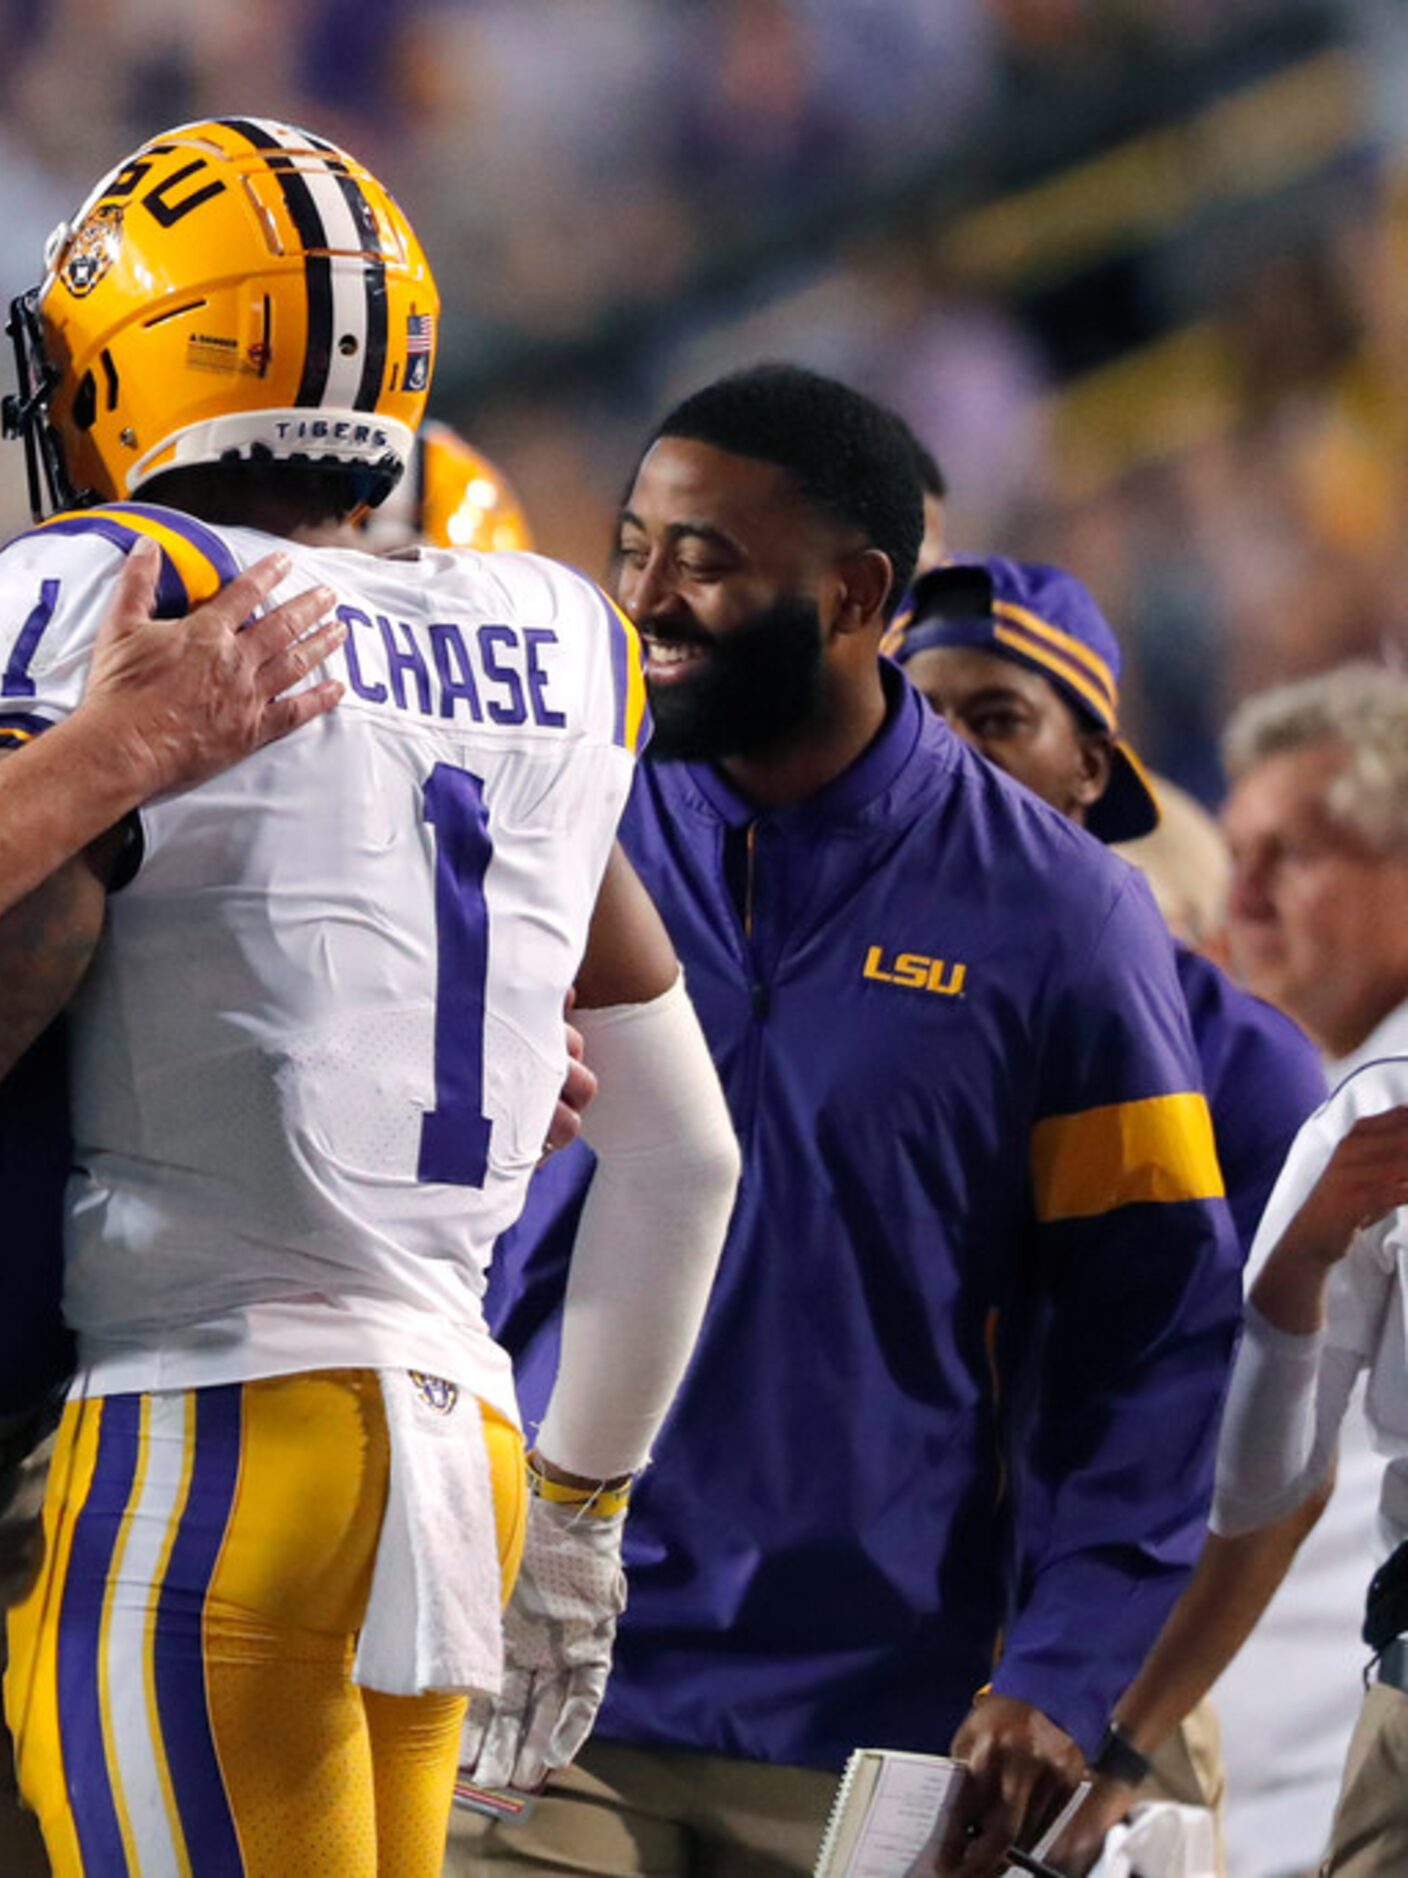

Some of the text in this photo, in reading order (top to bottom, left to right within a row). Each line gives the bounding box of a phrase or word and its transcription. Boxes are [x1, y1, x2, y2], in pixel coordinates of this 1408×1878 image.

[275, 421, 389, 446] TIGERS
[1, 579, 61, 698] 1
[337, 603, 567, 730] CHASE
[417, 761, 493, 1190] 1
[863, 944, 966, 996] LSU
